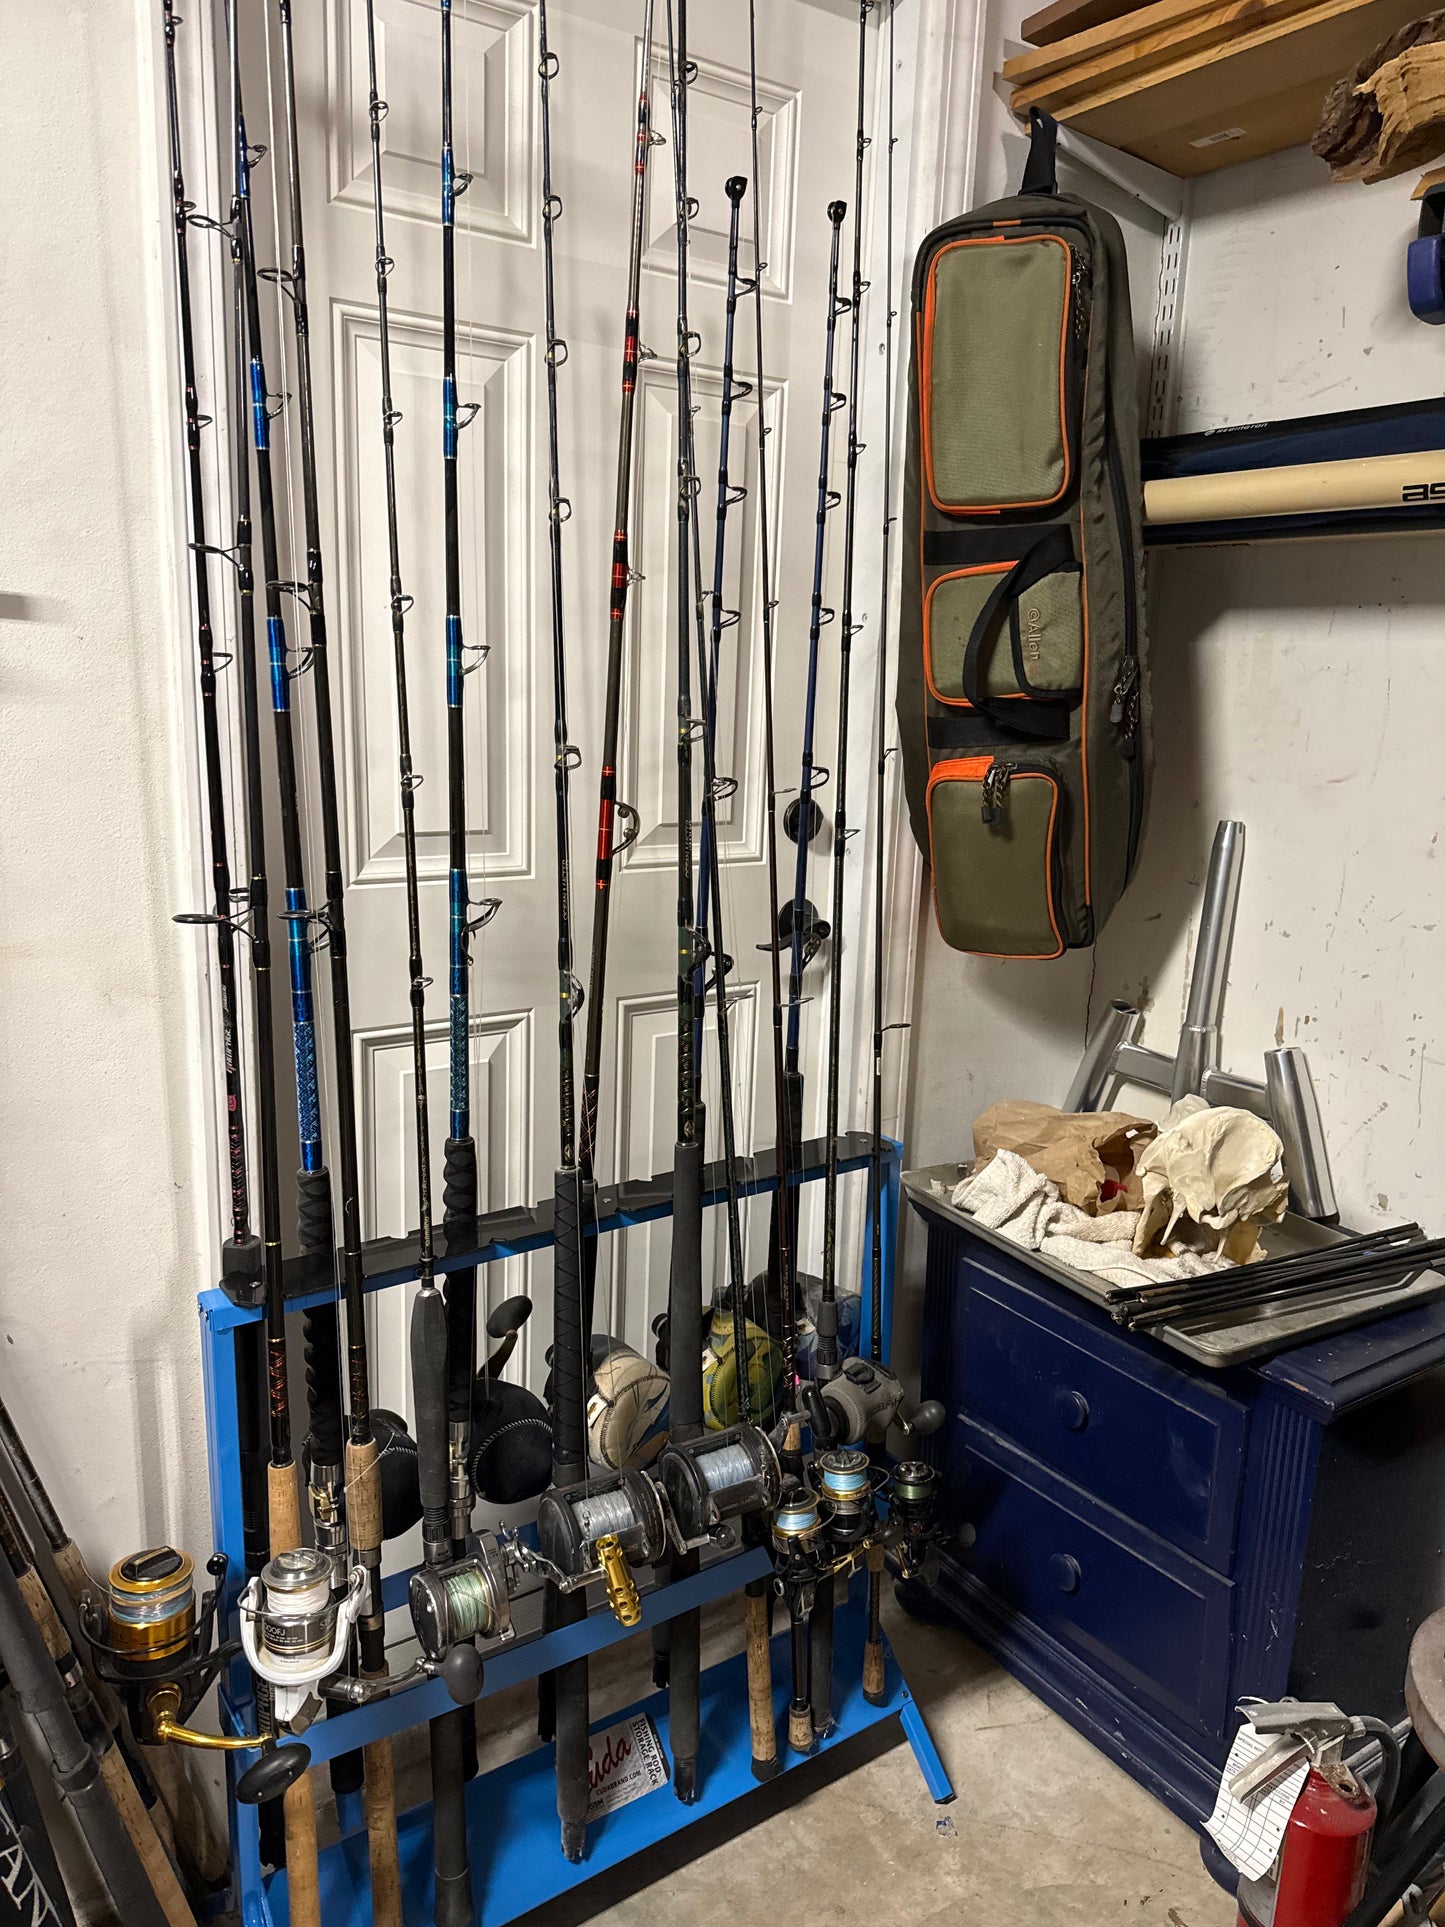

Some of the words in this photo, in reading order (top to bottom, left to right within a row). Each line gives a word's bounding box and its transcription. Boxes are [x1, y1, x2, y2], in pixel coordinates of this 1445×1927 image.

[1027, 618, 1041, 660] Allen
[256, 1678, 271, 1733] AMPAGE
[588, 1735, 632, 1790] uda
[632, 1720, 650, 1760] STORAGE
[646, 1761, 659, 1786] RACK
[638, 1718, 655, 1753] FISHING
[650, 1754, 662, 1774] ROD
[596, 1769, 642, 1796] CUDABRAND.COM
